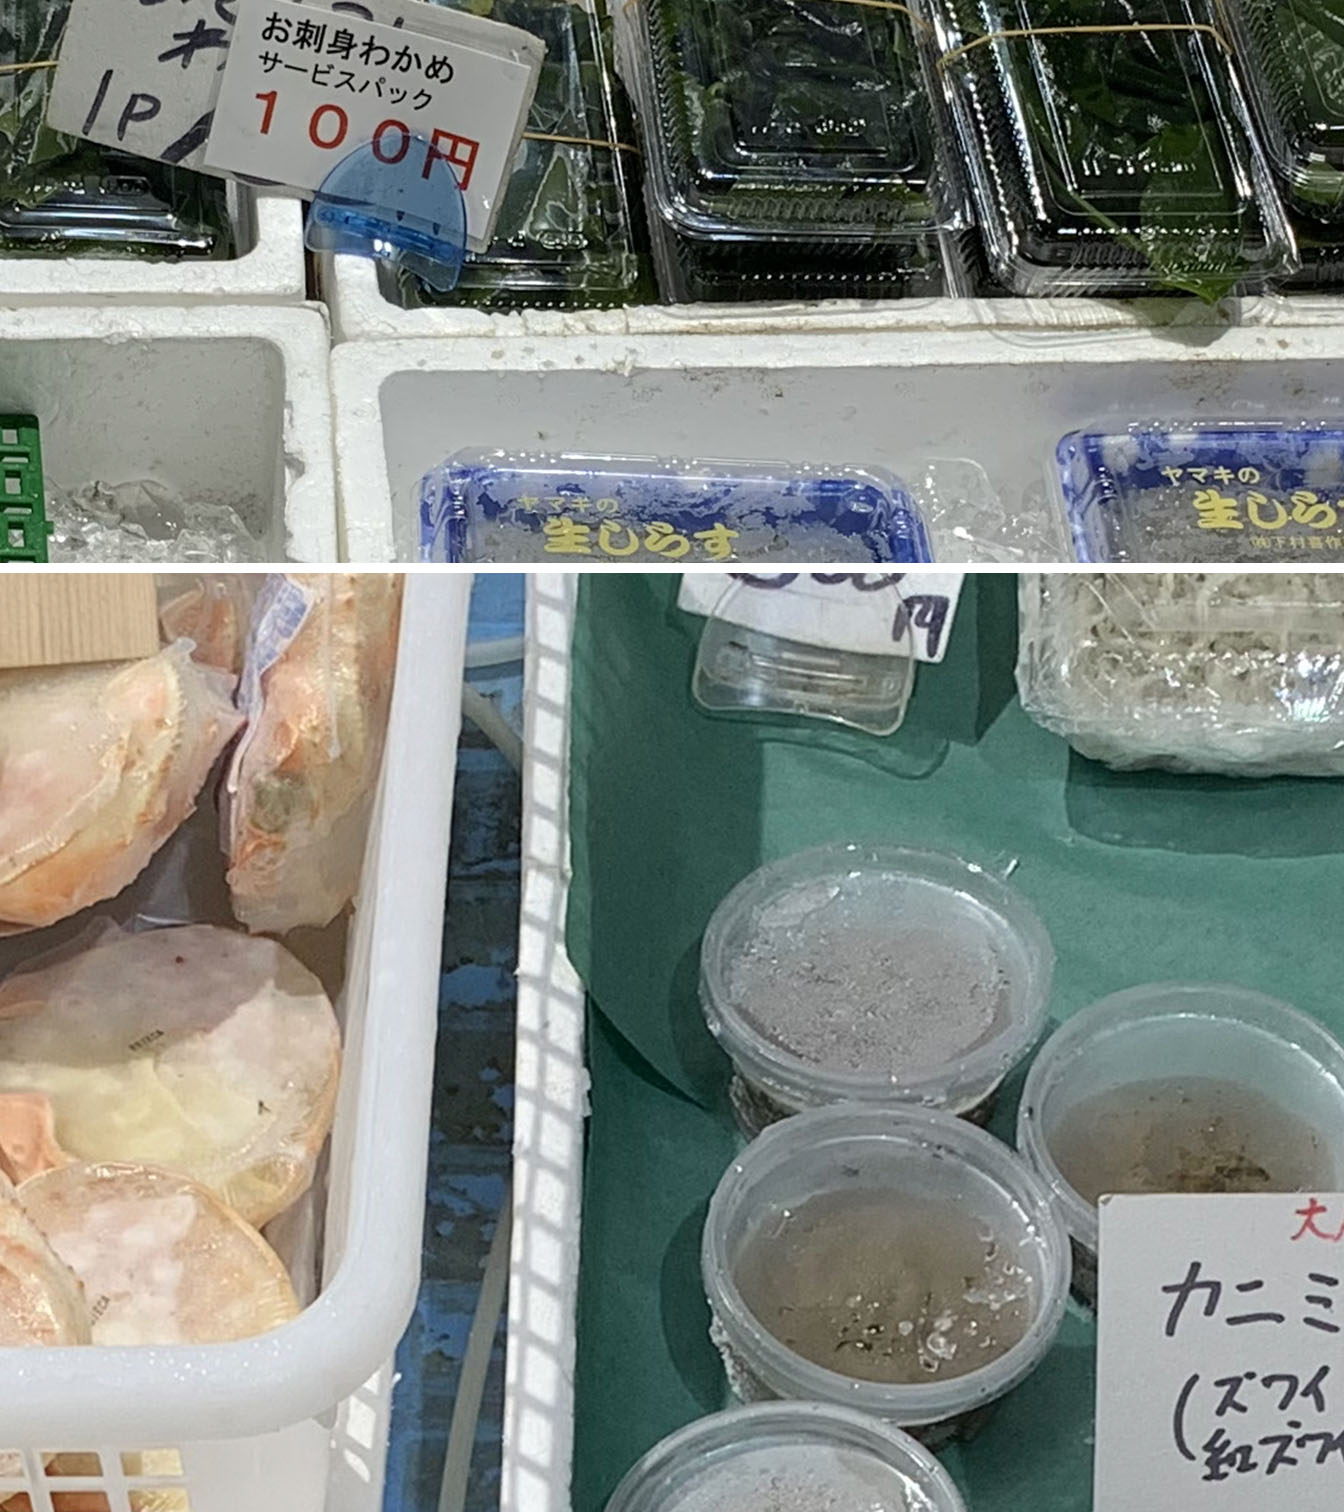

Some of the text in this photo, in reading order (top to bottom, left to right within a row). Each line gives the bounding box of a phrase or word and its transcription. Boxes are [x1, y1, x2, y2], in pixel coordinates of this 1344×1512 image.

[260, 10, 456, 86] お刺身わかめ
[259, 51, 433, 112] サービスパック
[255, 90, 481, 190] 100円
[1160, 465, 1261, 487] ヤマキの
[517, 493, 618, 513] ヤマキの
[543, 515, 740, 560] 生しらす
